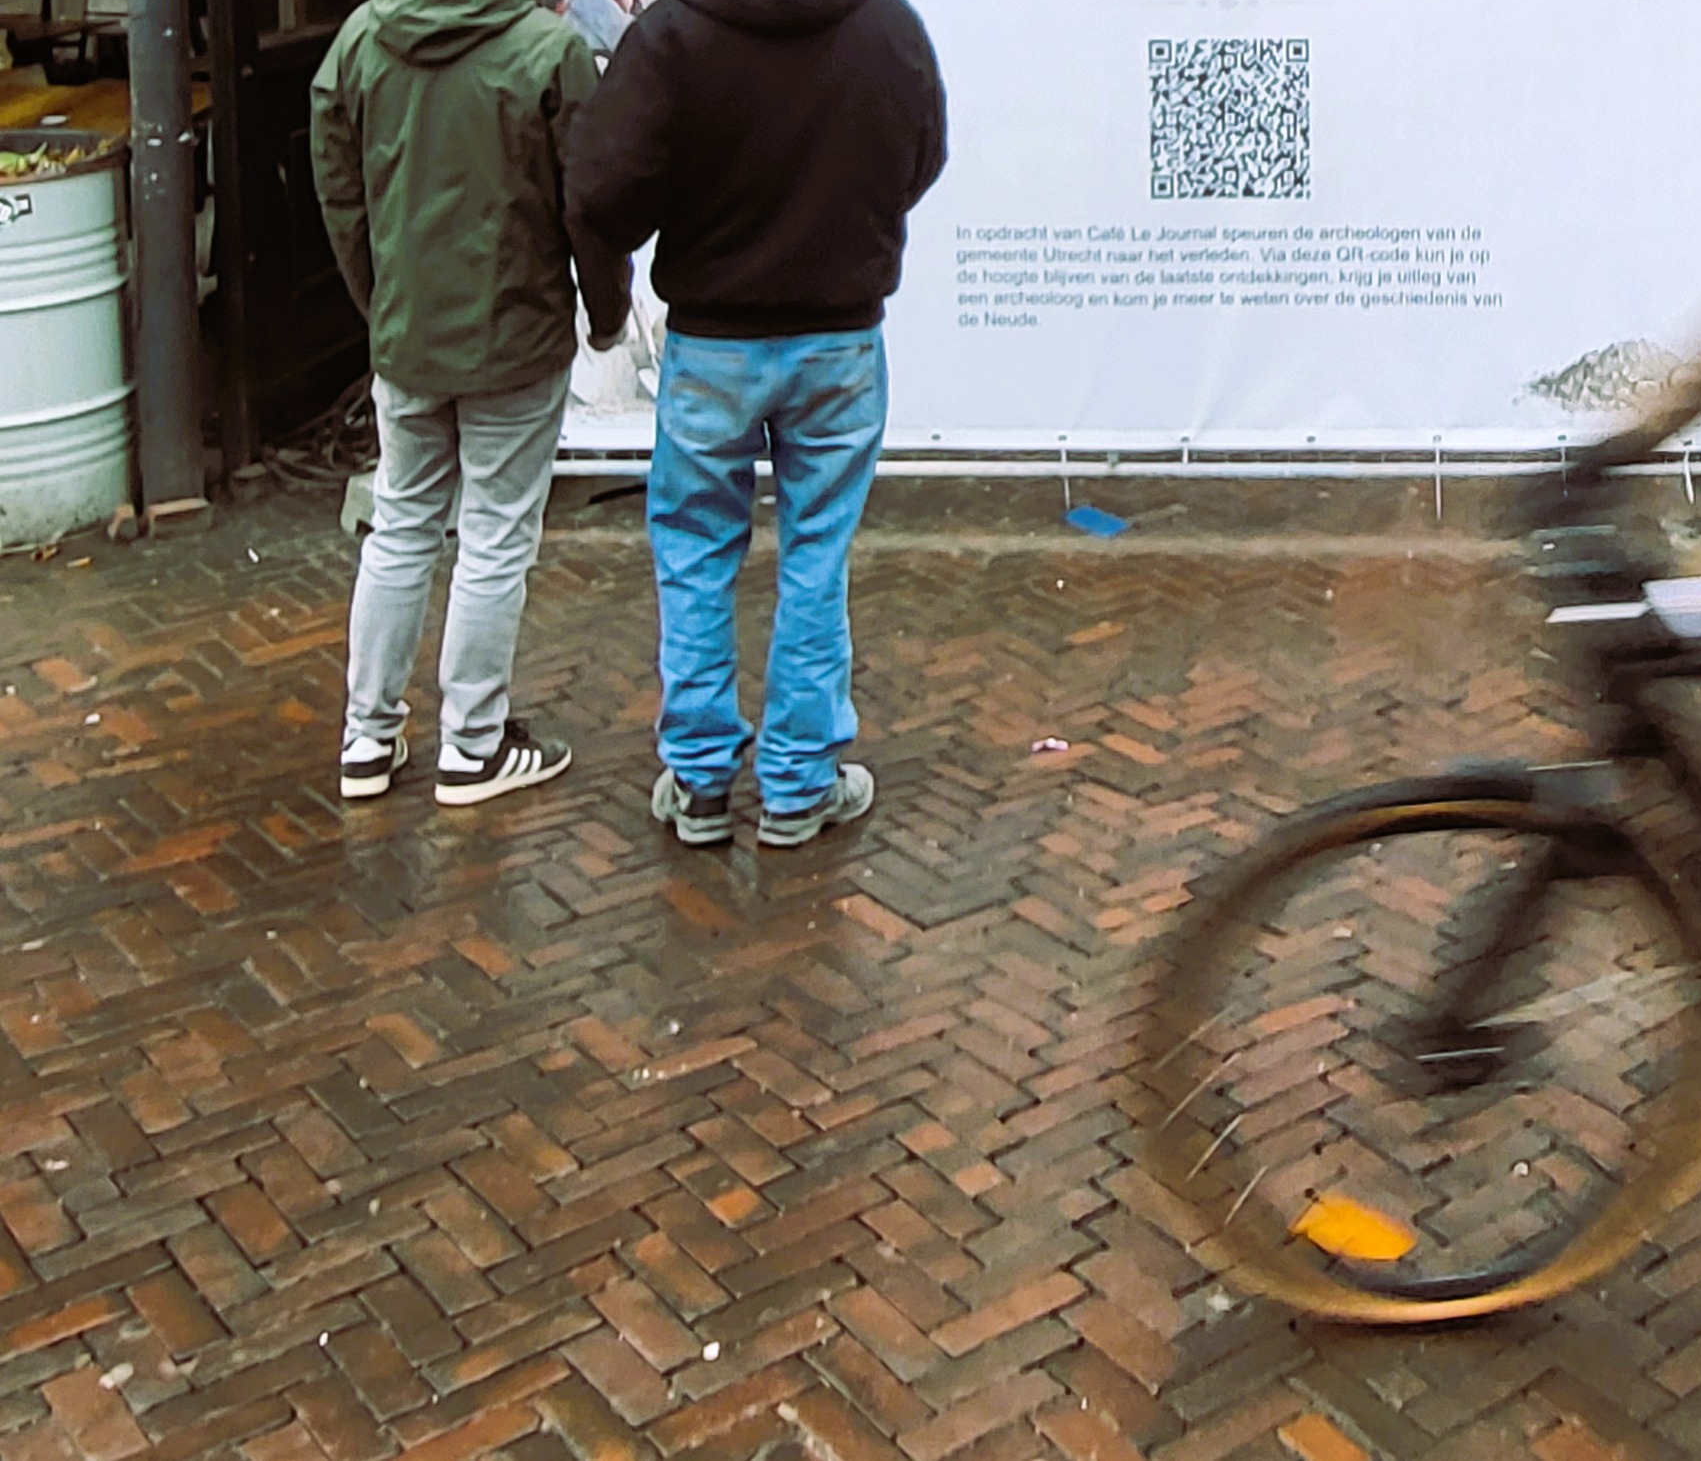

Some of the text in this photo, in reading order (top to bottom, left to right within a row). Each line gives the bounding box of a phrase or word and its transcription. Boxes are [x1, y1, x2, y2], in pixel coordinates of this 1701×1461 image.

[956, 225, 972, 240] In
[1053, 228, 1083, 240] van
[1156, 225, 1217, 241] Journal
[1222, 226, 1288, 242] speuren
[1293, 226, 1314, 241] de
[1319, 225, 1421, 243] archeologen
[1426, 227, 1456, 241] van
[1461, 225, 1482, 241] de
[956, 248, 1038, 264] gemeente
[1106, 250, 1143, 262] naar
[1148, 248, 1174, 262] het
[1260, 246, 1287, 262] Via
[1291, 246, 1331, 262] deze
[1336, 246, 1410, 263] QR-code
[1415, 247, 1445, 263] kun
[1449, 247, 1464, 266] je
[1469, 248, 1490, 266] op
[956, 269, 977, 284] de
[982, 268, 1039, 287] hoogte
[1100, 271, 1130, 285] van
[1134, 269, 1155, 285] de
[1338, 269, 1373, 287] krijg
[1377, 268, 1392, 288] je
[1397, 268, 1442, 287] uitleg
[1447, 271, 1477, 285] van
[1088, 293, 1109, 306] en
[1113, 291, 1149, 307] kom
[1152, 291, 1168, 311] je
[1172, 292, 1215, 307] meer
[1219, 290, 1235, 307] te
[1240, 291, 1290, 307] weten
[1293, 292, 1330, 307] over
[1334, 290, 1356, 307] de
[1360, 289, 1468, 310] geschiedenis
[1472, 292, 1504, 308] van
[958, 311, 979, 328] de
